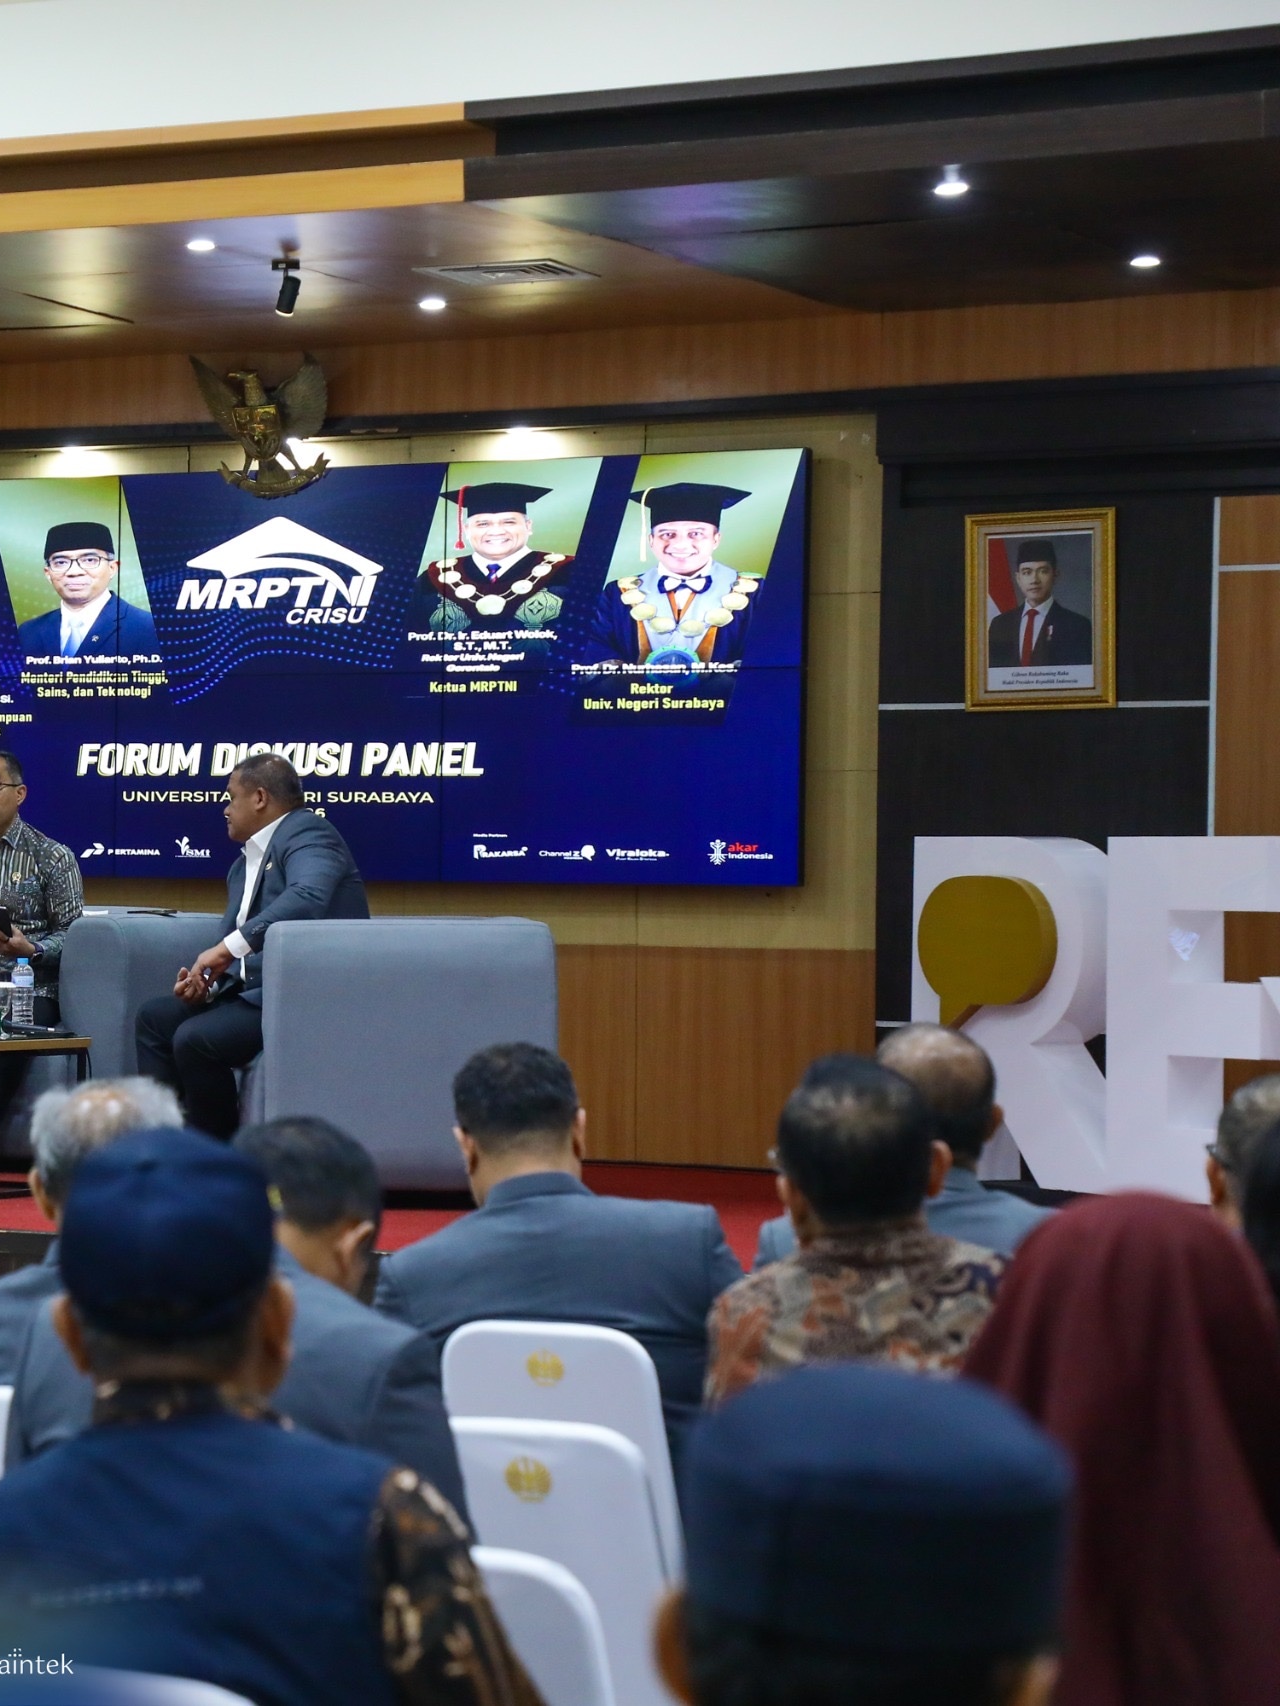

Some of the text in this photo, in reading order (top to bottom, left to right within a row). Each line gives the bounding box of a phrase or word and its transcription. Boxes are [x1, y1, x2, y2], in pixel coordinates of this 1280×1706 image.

[286, 608, 367, 624] CRISU
[408, 632, 436, 641] Prof.
[438, 632, 456, 640] Dr.
[471, 631, 513, 640] Eduart
[483, 641, 511, 650] M.T.
[26, 656, 51, 664] Prof.
[53, 656, 82, 664] Brian
[133, 655, 162, 663] Ph.D.
[21, 672, 63, 684] Menteri
[131, 670, 168, 684] Tinggi,
[37, 686, 151, 698] Sains, dan Teknologi
[429, 681, 517, 693] Ketua MRPTNI
[630, 683, 673, 694] Rektor
[584, 697, 724, 711] Univ. Negeri Surabaya
[76, 742, 203, 777] FORUM
[360, 742, 484, 777] PANEL
[122, 790, 233, 803] UNIVERSITA
[327, 791, 434, 804] SURABAYA
[728, 842, 758, 852] akar
